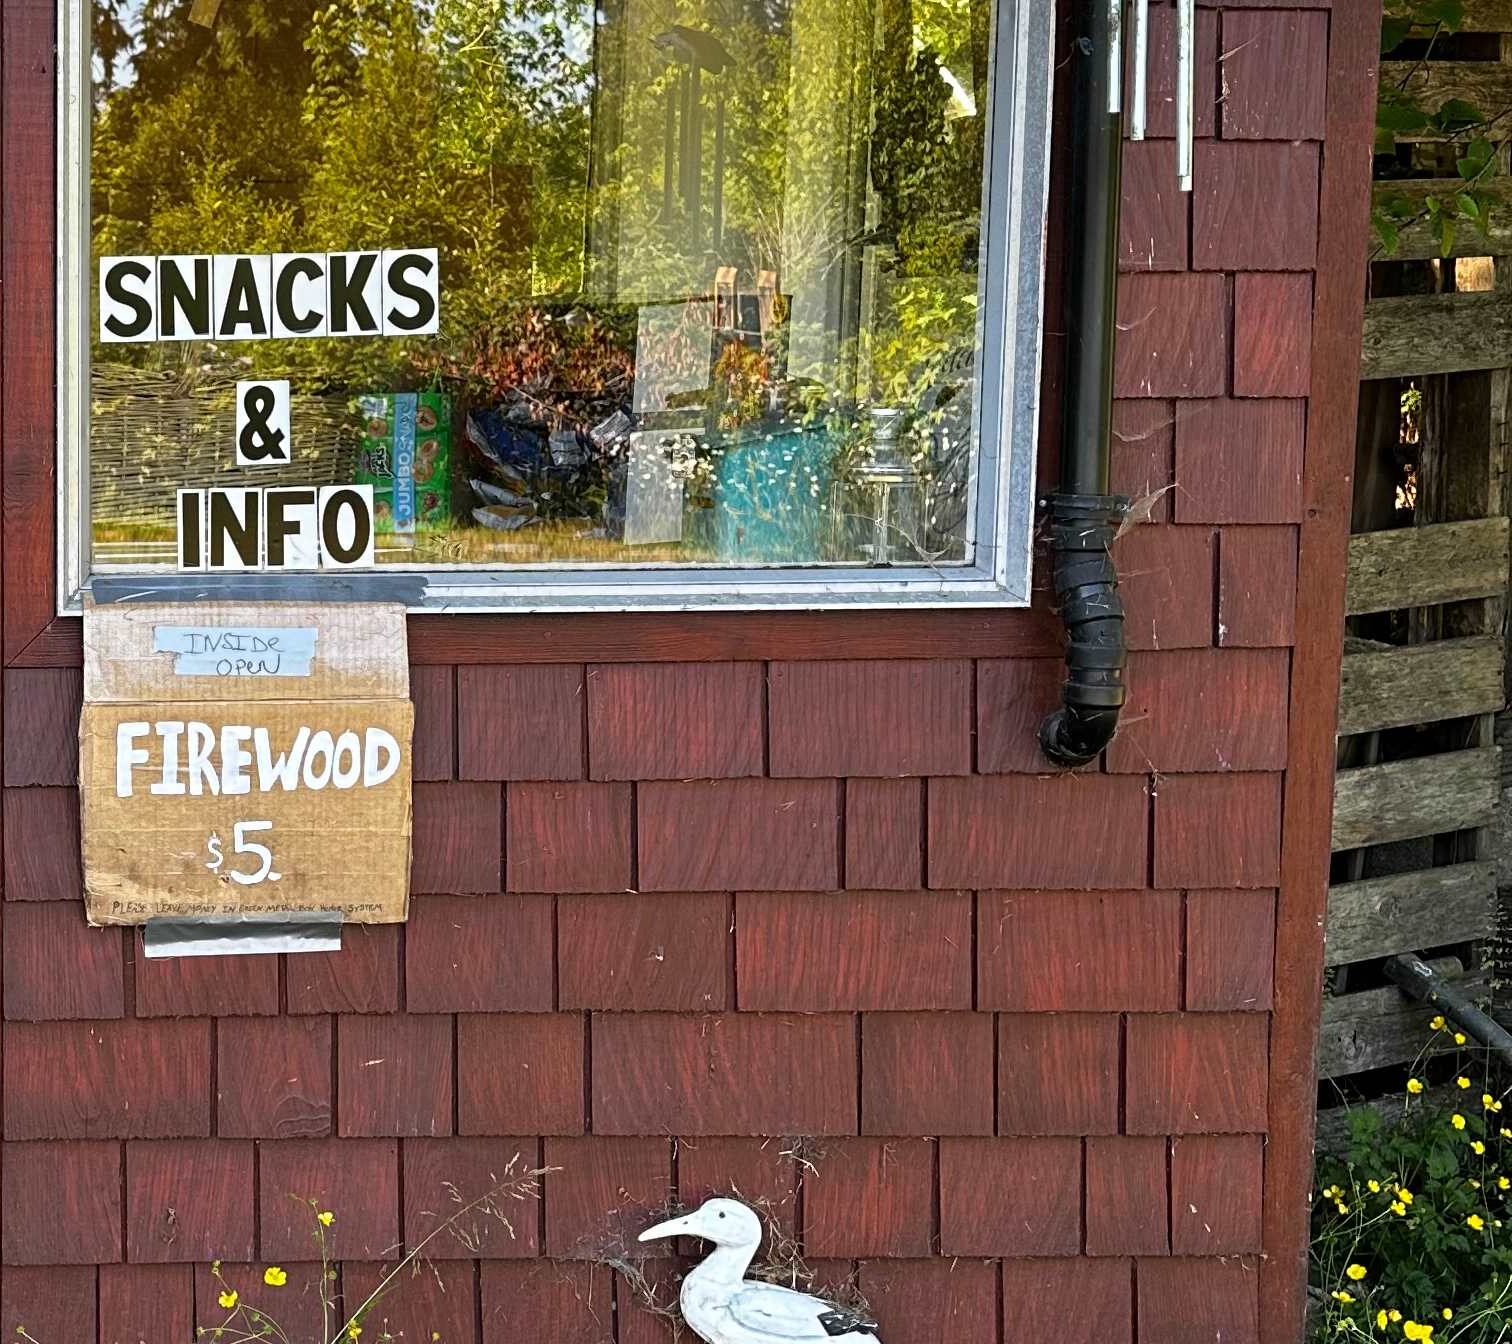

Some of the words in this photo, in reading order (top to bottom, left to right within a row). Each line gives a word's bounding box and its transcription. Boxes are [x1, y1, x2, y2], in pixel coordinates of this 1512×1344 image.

[104, 254, 436, 337] SNACKS
[239, 385, 287, 461] &
[397, 453, 411, 515] JUMBO
[182, 489, 370, 568] INFO
[116, 721, 401, 797] FIREWOOD
